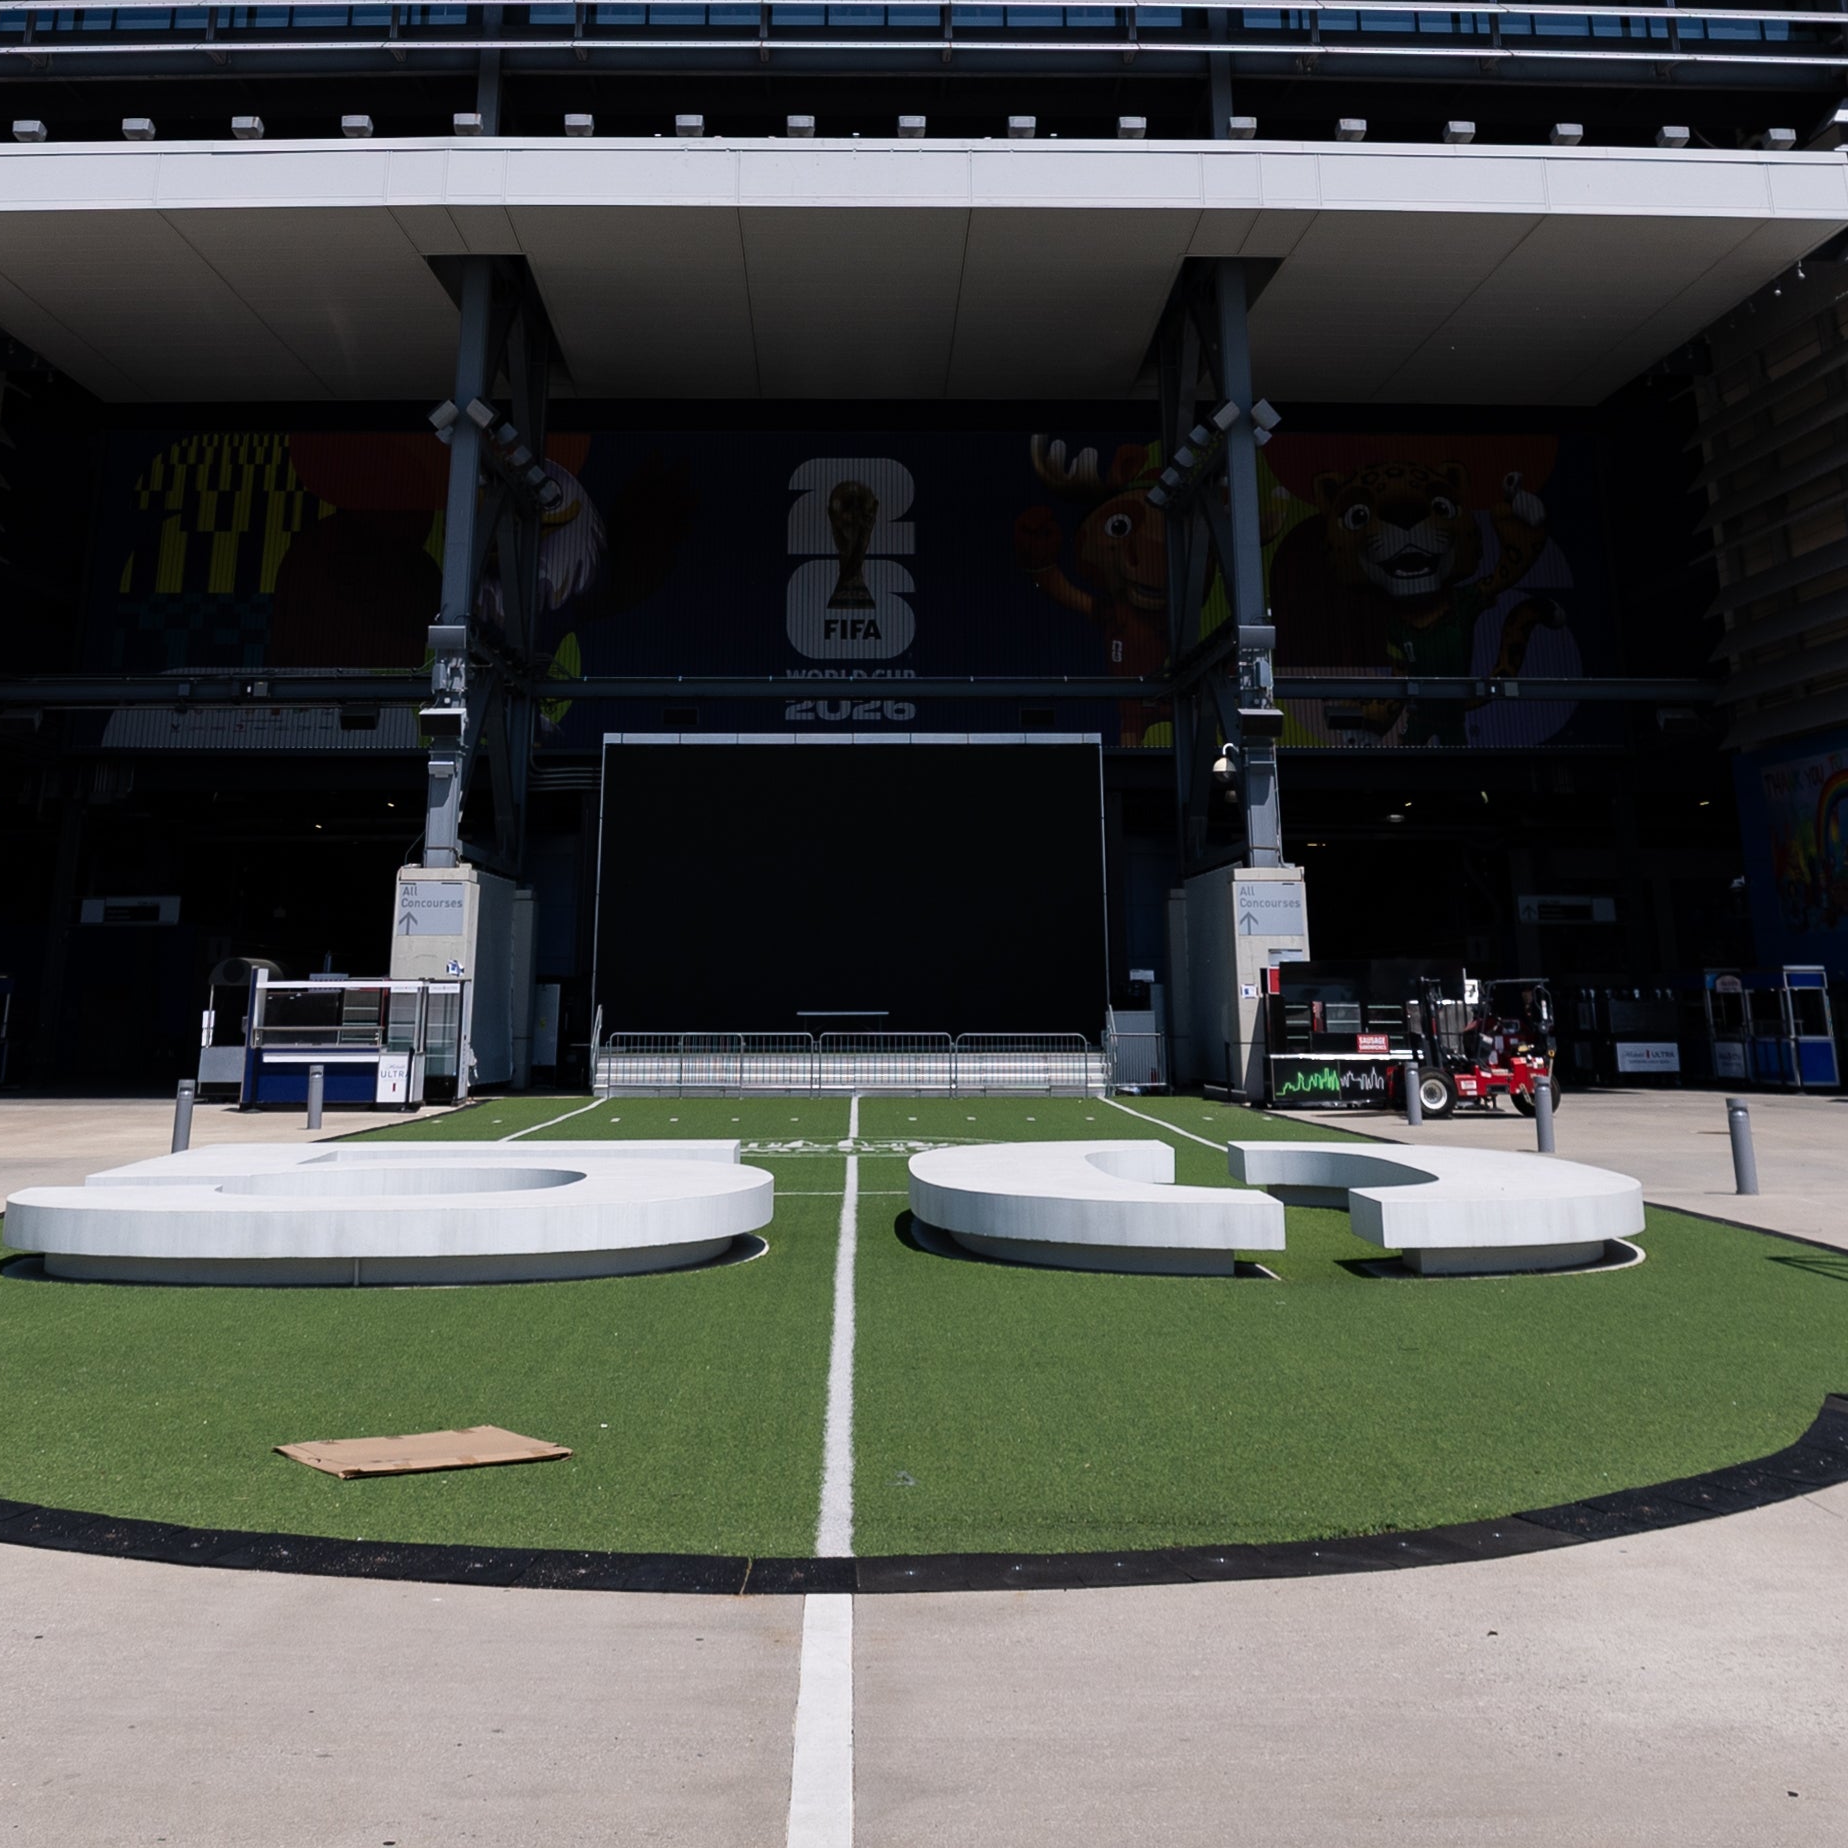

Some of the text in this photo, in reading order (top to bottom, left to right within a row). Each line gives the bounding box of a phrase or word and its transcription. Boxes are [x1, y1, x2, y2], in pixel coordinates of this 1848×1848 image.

[824, 619, 882, 640] FIFA
[785, 700, 916, 721] 2026
[1764, 767, 1802, 800] THANK
[1804, 764, 1824, 790] YOU
[1827, 753, 1842, 770] TO
[402, 886, 418, 897] All
[1240, 886, 1255, 896] All
[401, 898, 463, 908] Concourses
[1240, 898, 1301, 908] Concourses
